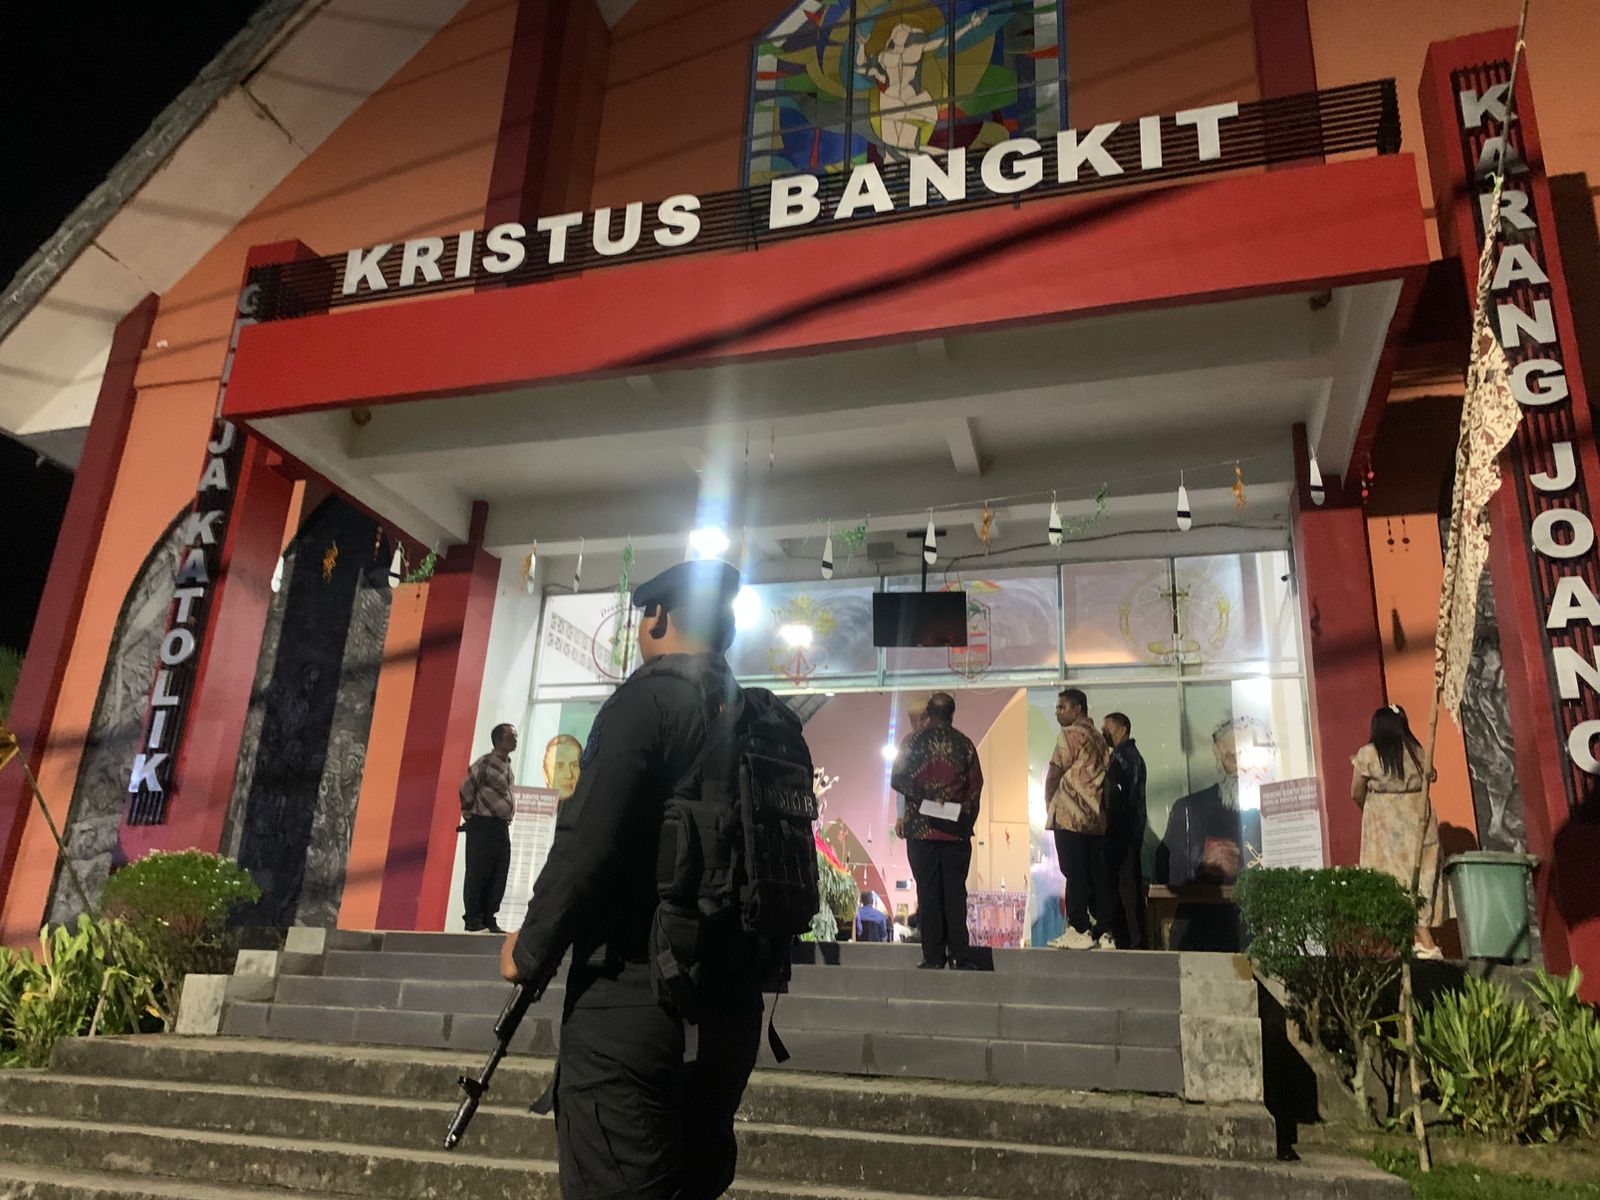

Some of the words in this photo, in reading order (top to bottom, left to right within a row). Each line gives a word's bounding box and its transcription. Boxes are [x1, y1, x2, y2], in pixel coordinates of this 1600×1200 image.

[342, 193, 701, 296] KRISTUS
[768, 101, 1239, 230] BANGKIT
[1459, 80, 1569, 406] KARANG
[127, 509, 225, 793] KATOLIK
